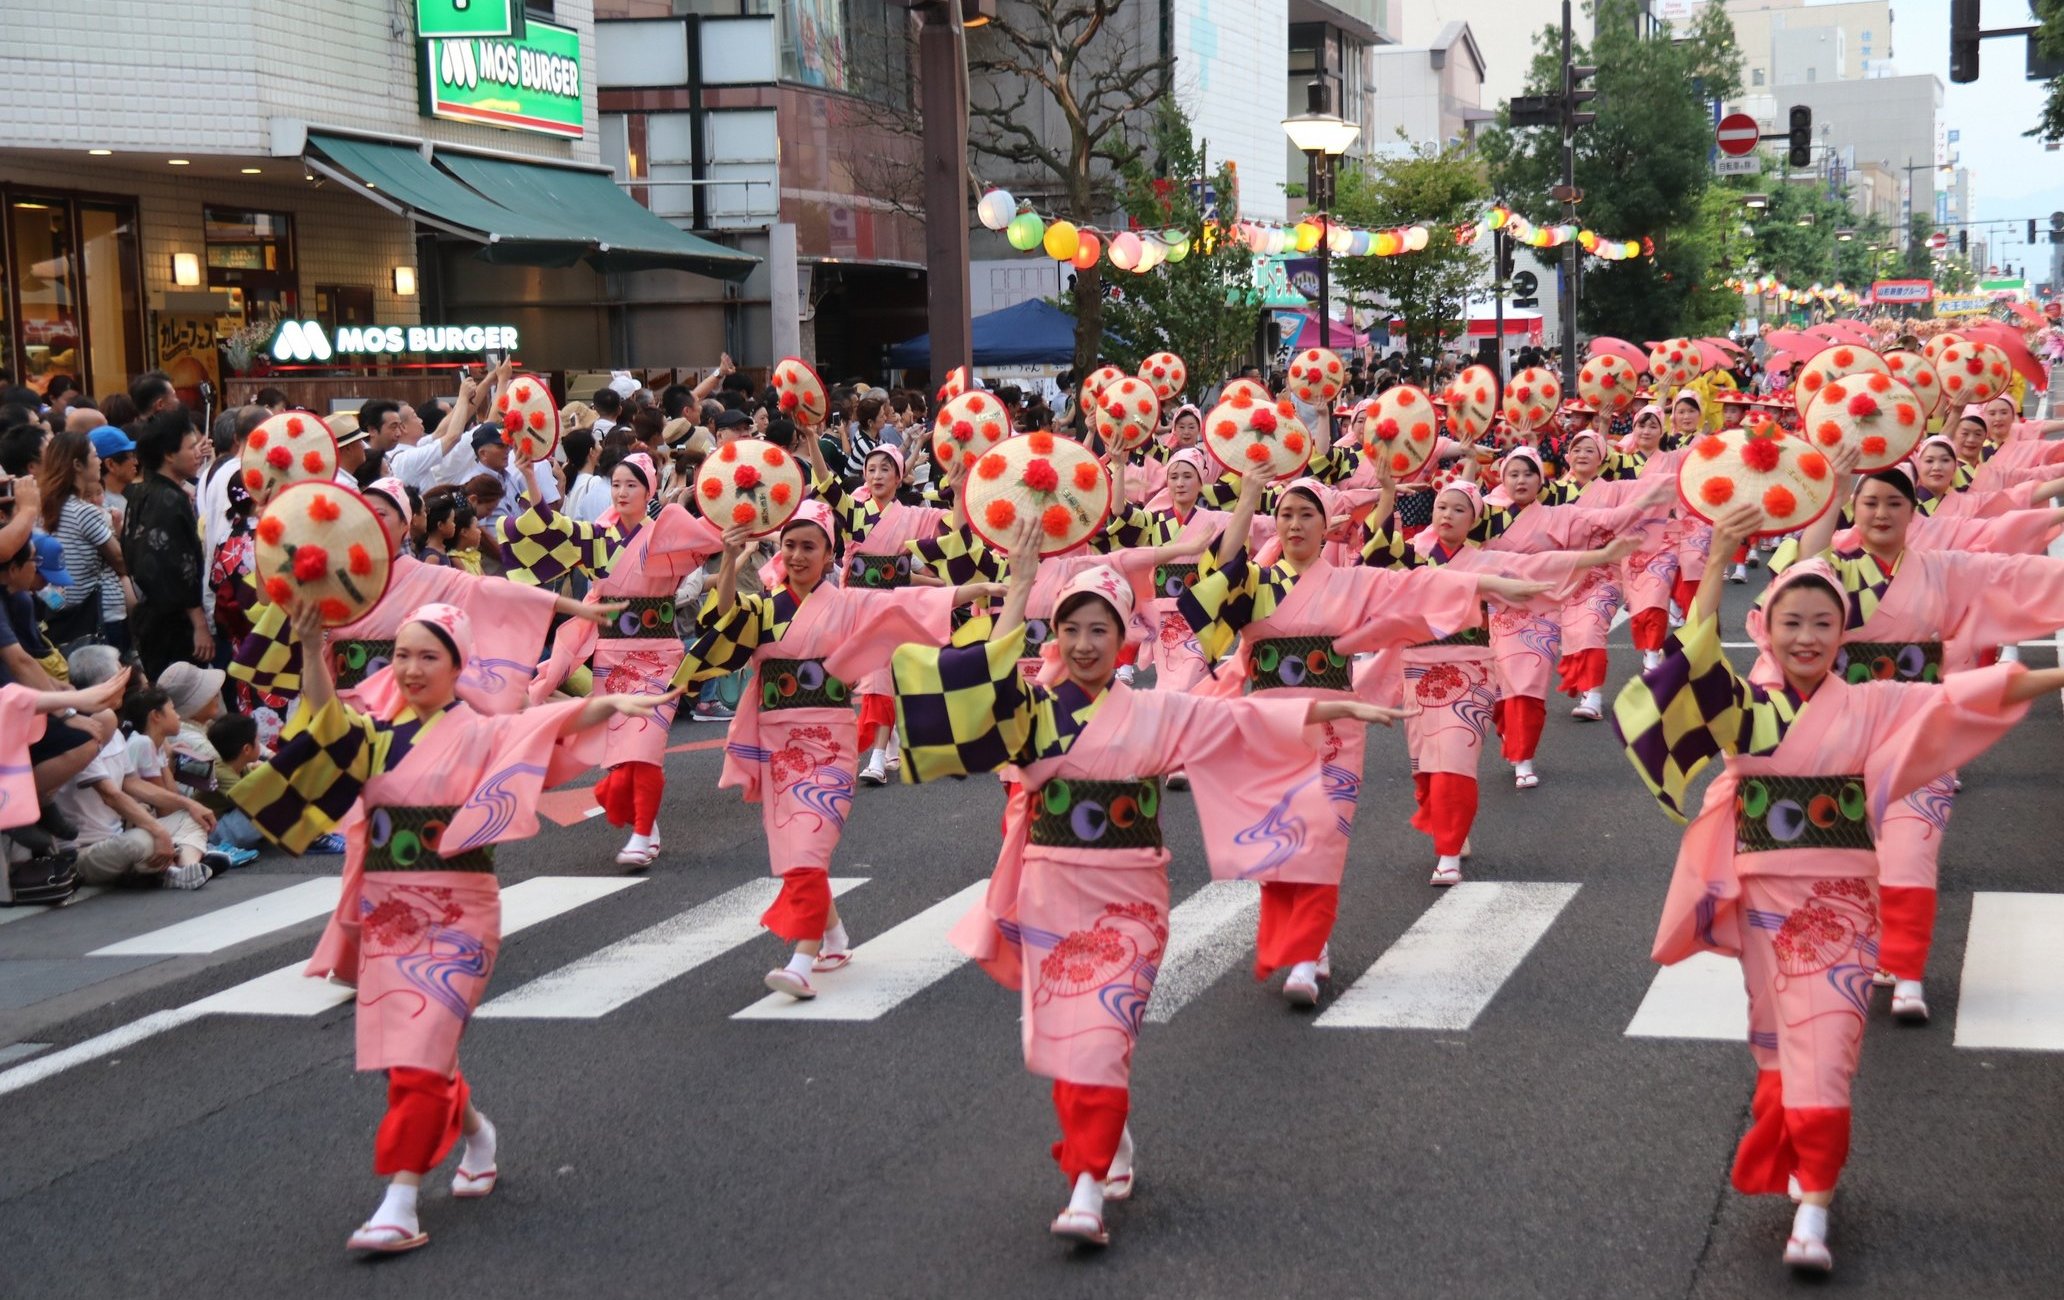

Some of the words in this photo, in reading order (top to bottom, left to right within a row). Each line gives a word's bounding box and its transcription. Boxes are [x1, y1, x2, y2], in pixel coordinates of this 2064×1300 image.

[479, 41, 519, 86] MOS
[520, 48, 579, 97] BURGER
[337, 327, 405, 352] MOS
[408, 326, 519, 352] BURGER
